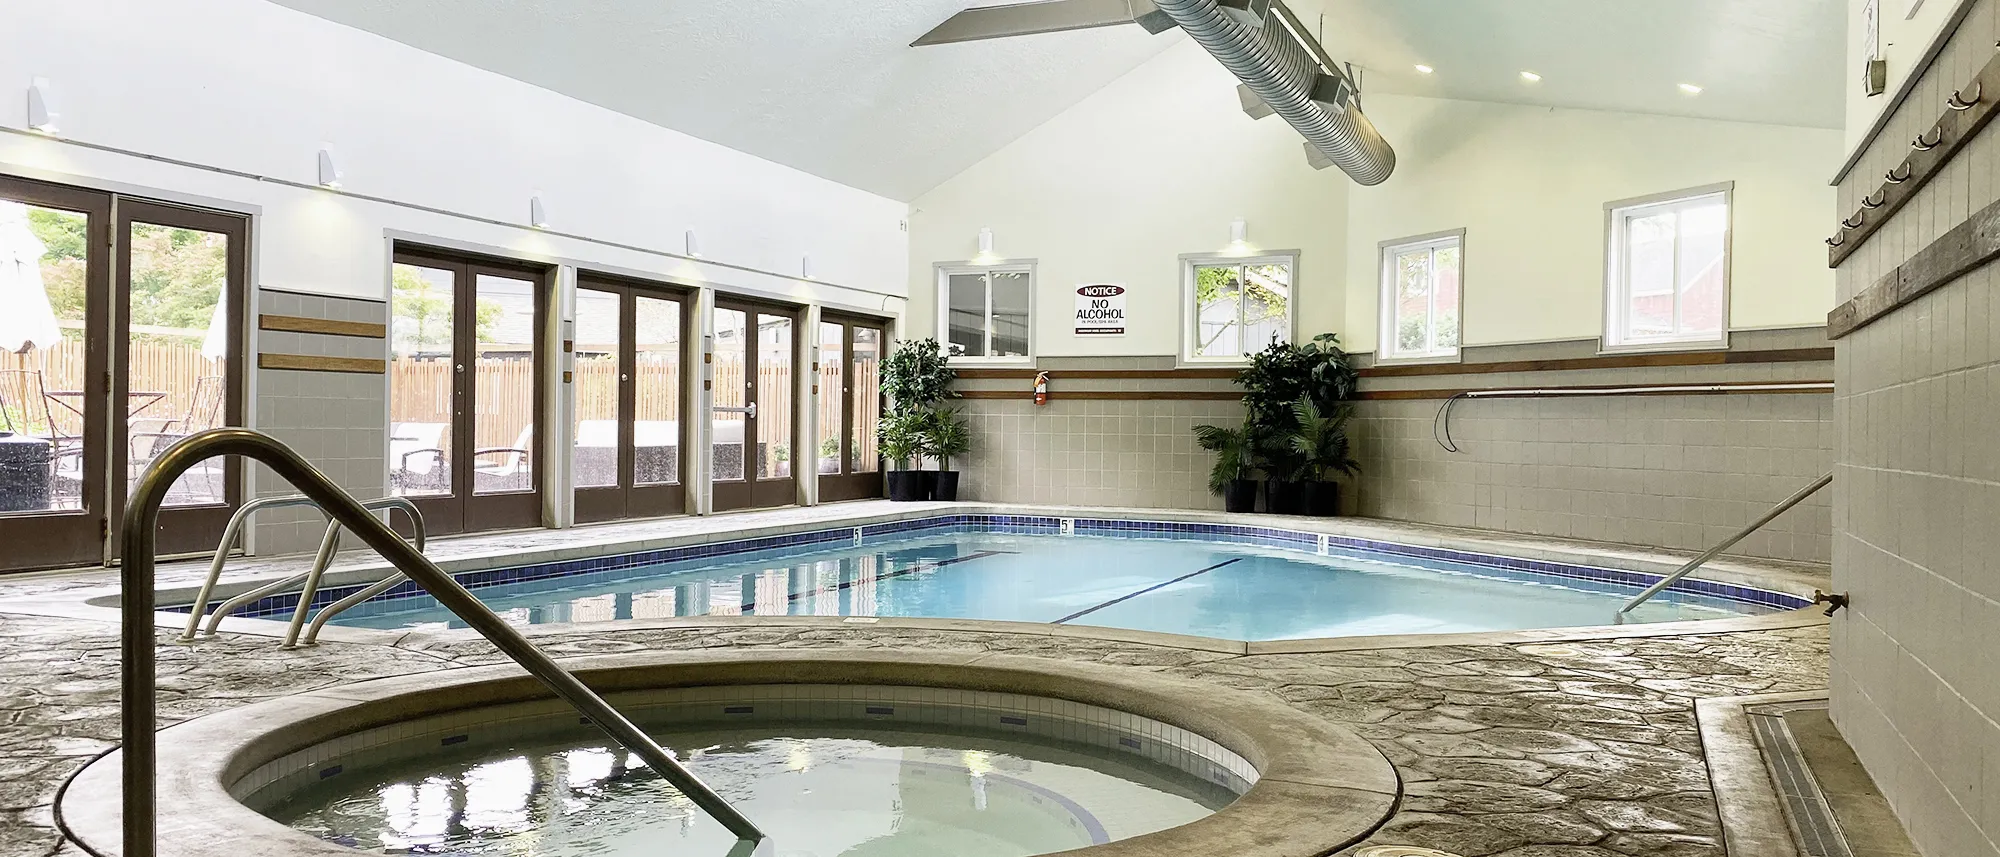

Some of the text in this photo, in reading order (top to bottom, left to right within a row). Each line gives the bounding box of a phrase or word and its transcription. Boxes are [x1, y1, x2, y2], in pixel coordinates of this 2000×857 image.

[1084, 287, 1117, 296] NOTICE
[1091, 299, 1109, 309] NO
[1076, 309, 1124, 319] ALCOHOL
